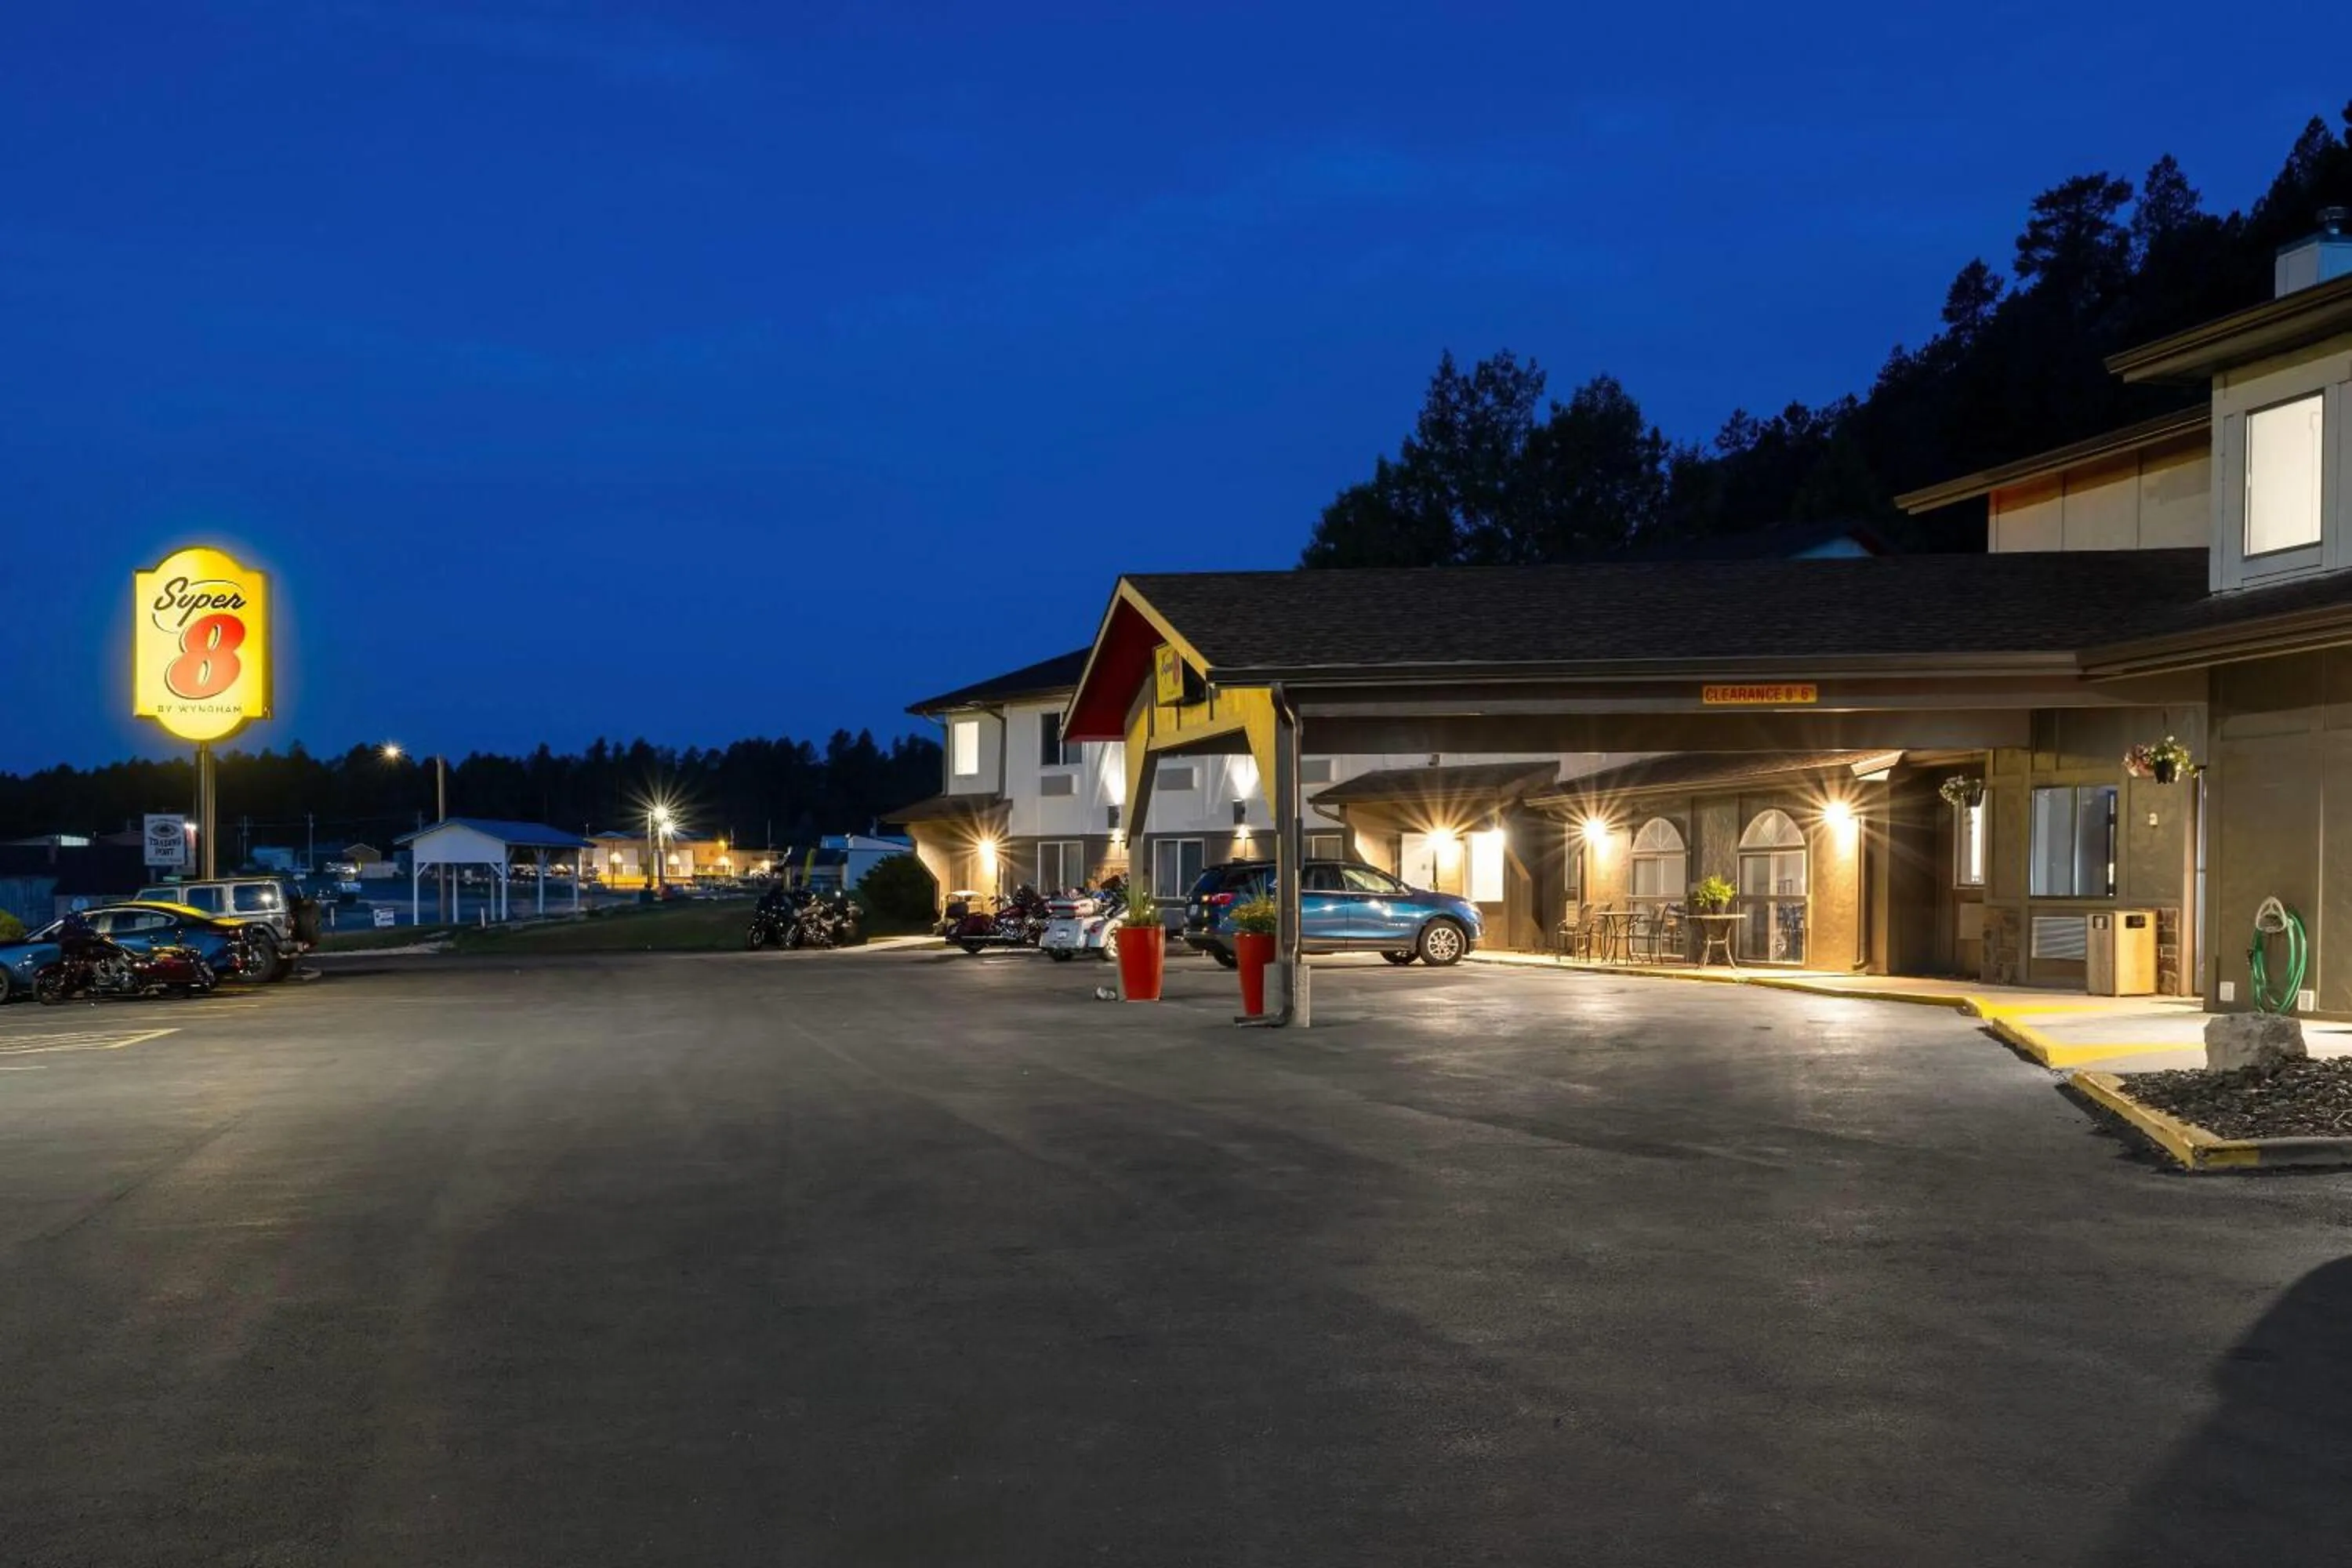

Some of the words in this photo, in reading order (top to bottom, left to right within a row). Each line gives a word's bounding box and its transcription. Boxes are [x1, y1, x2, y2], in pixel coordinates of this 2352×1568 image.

[153, 577, 246, 627] Super
[165, 613, 245, 699] 8
[1705, 687, 1782, 702] CLEARANCE
